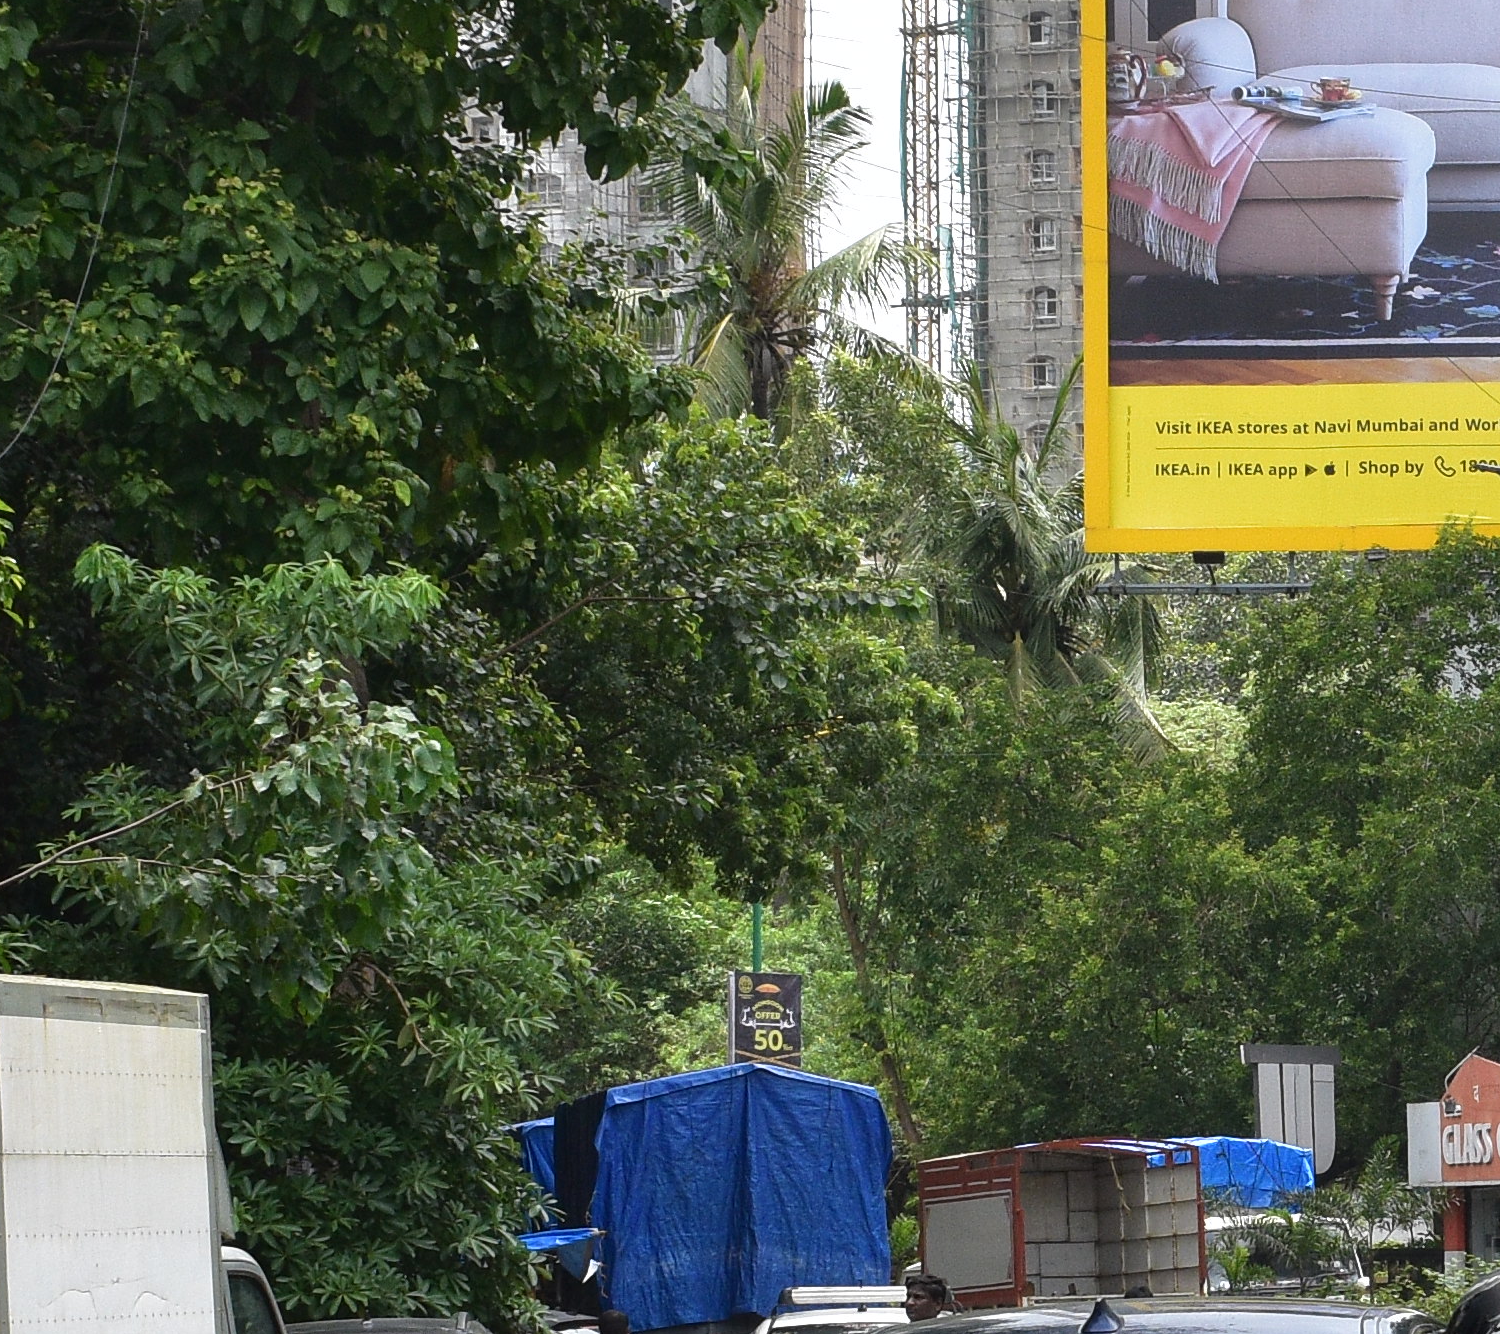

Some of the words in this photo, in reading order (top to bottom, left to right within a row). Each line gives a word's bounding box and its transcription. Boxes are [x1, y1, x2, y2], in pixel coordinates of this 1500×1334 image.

[1156, 421, 1192, 435] Visit
[1197, 420, 1233, 434] IKEA
[1238, 421, 1288, 434] stores
[1293, 422, 1309, 434] at
[1314, 419, 1351, 434] Navi
[1356, 418, 1424, 434] Mumbai
[1429, 418, 1459, 433] and
[1155, 462, 1210, 477] IKEA.in
[1228, 462, 1264, 476] IKEA
[1268, 464, 1298, 480] app
[1358, 460, 1396, 479] Shop
[1404, 460, 1424, 478] by
[754, 1029, 783, 1051] 50
[1442, 1123, 1494, 1166] GLASS
